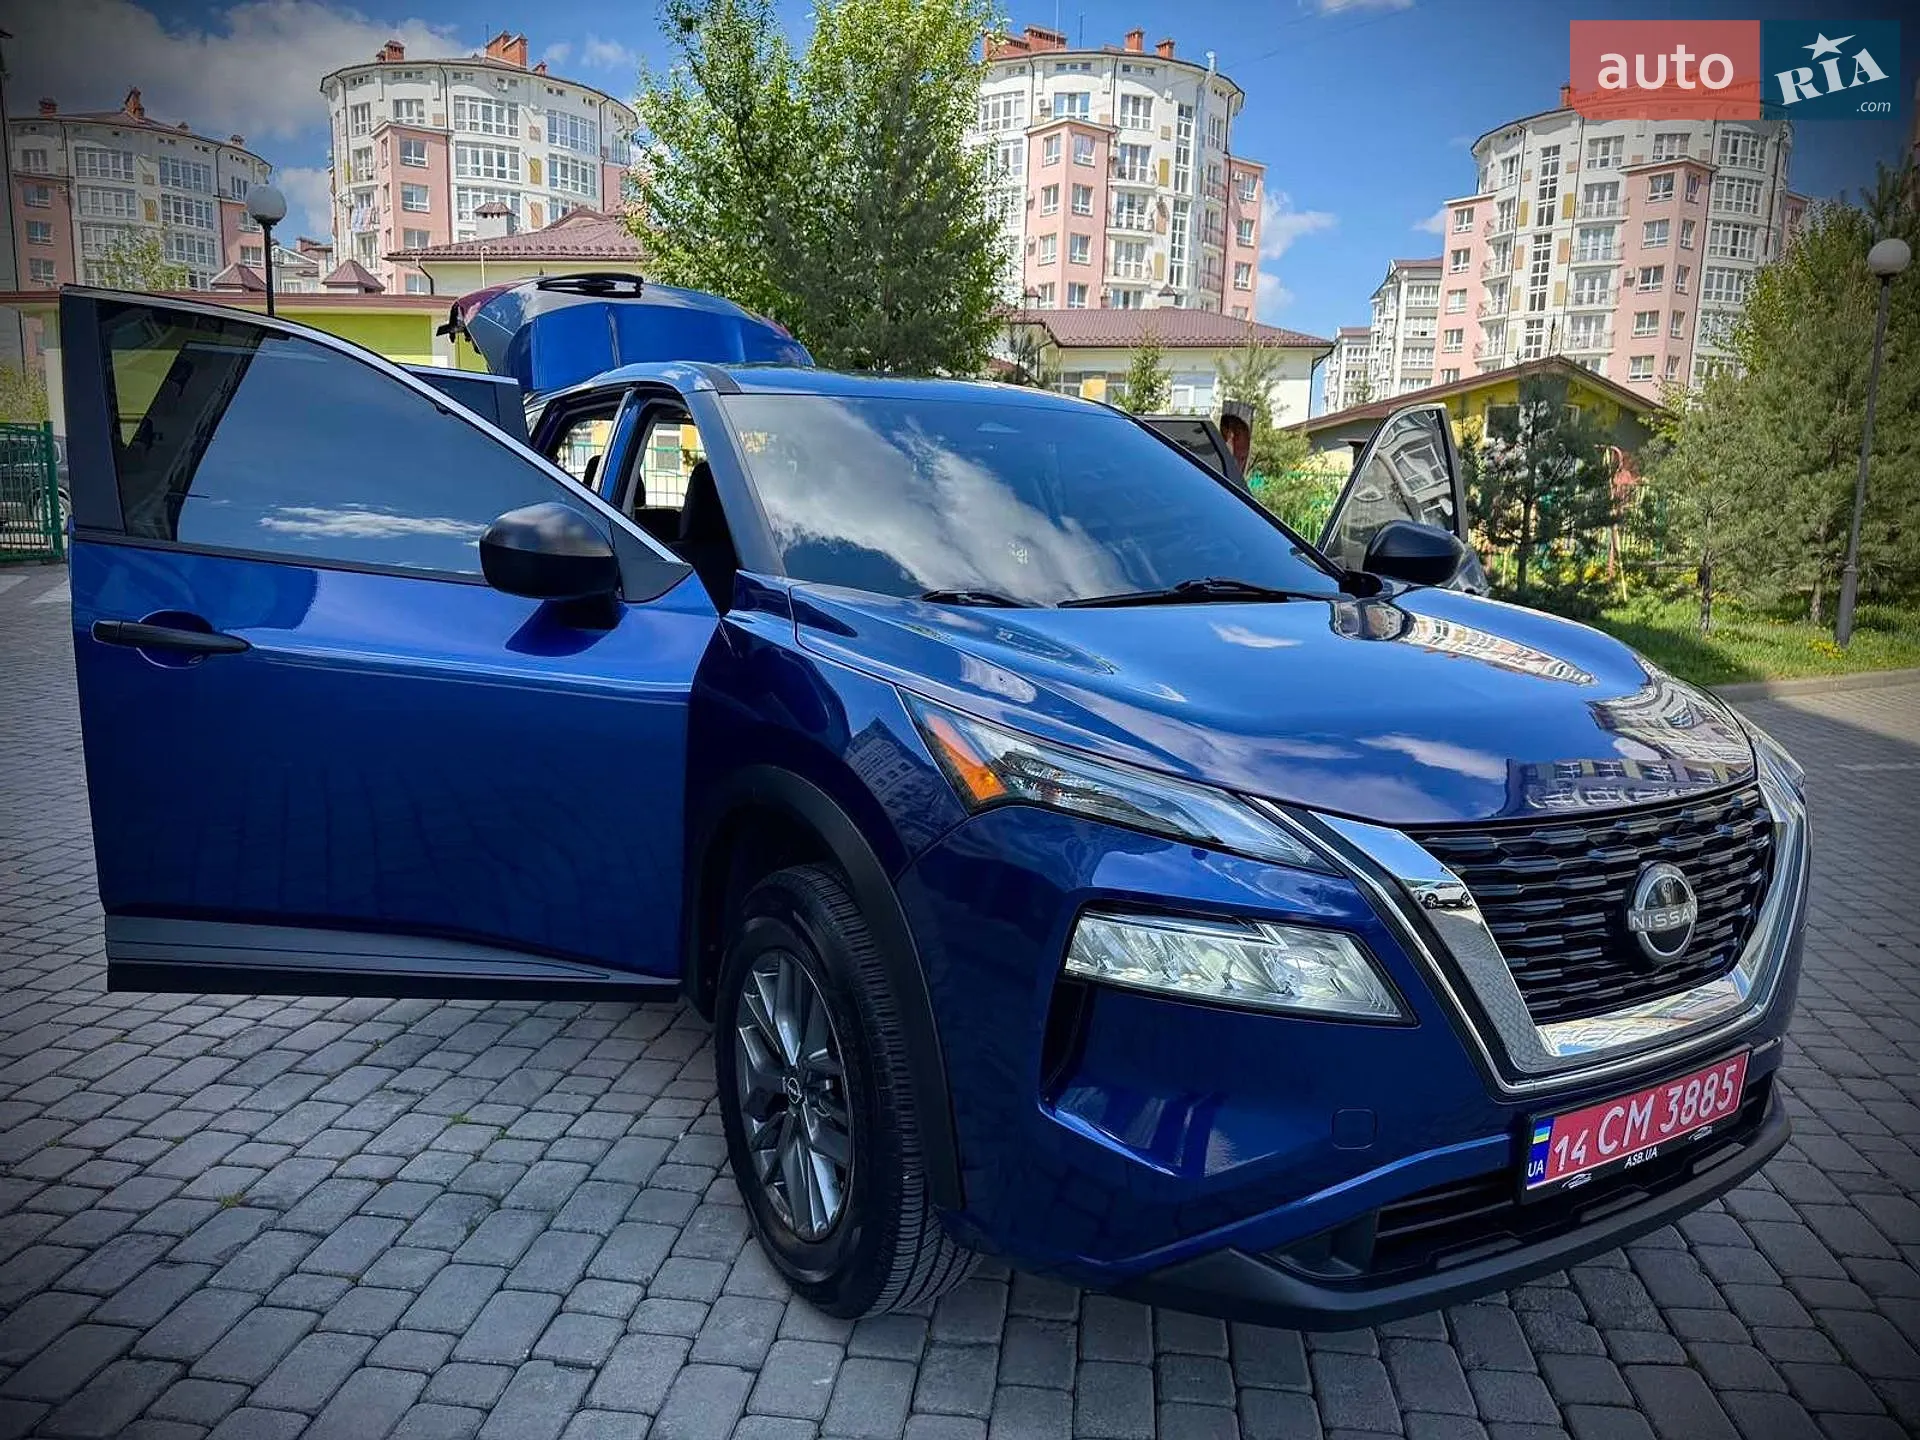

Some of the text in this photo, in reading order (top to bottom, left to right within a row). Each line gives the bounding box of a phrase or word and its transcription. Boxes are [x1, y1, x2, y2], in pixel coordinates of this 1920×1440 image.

[1632, 903, 1697, 928] NISSAN
[1554, 1064, 1738, 1171] 14 CM 3885
[1527, 1160, 1544, 1178] UA
